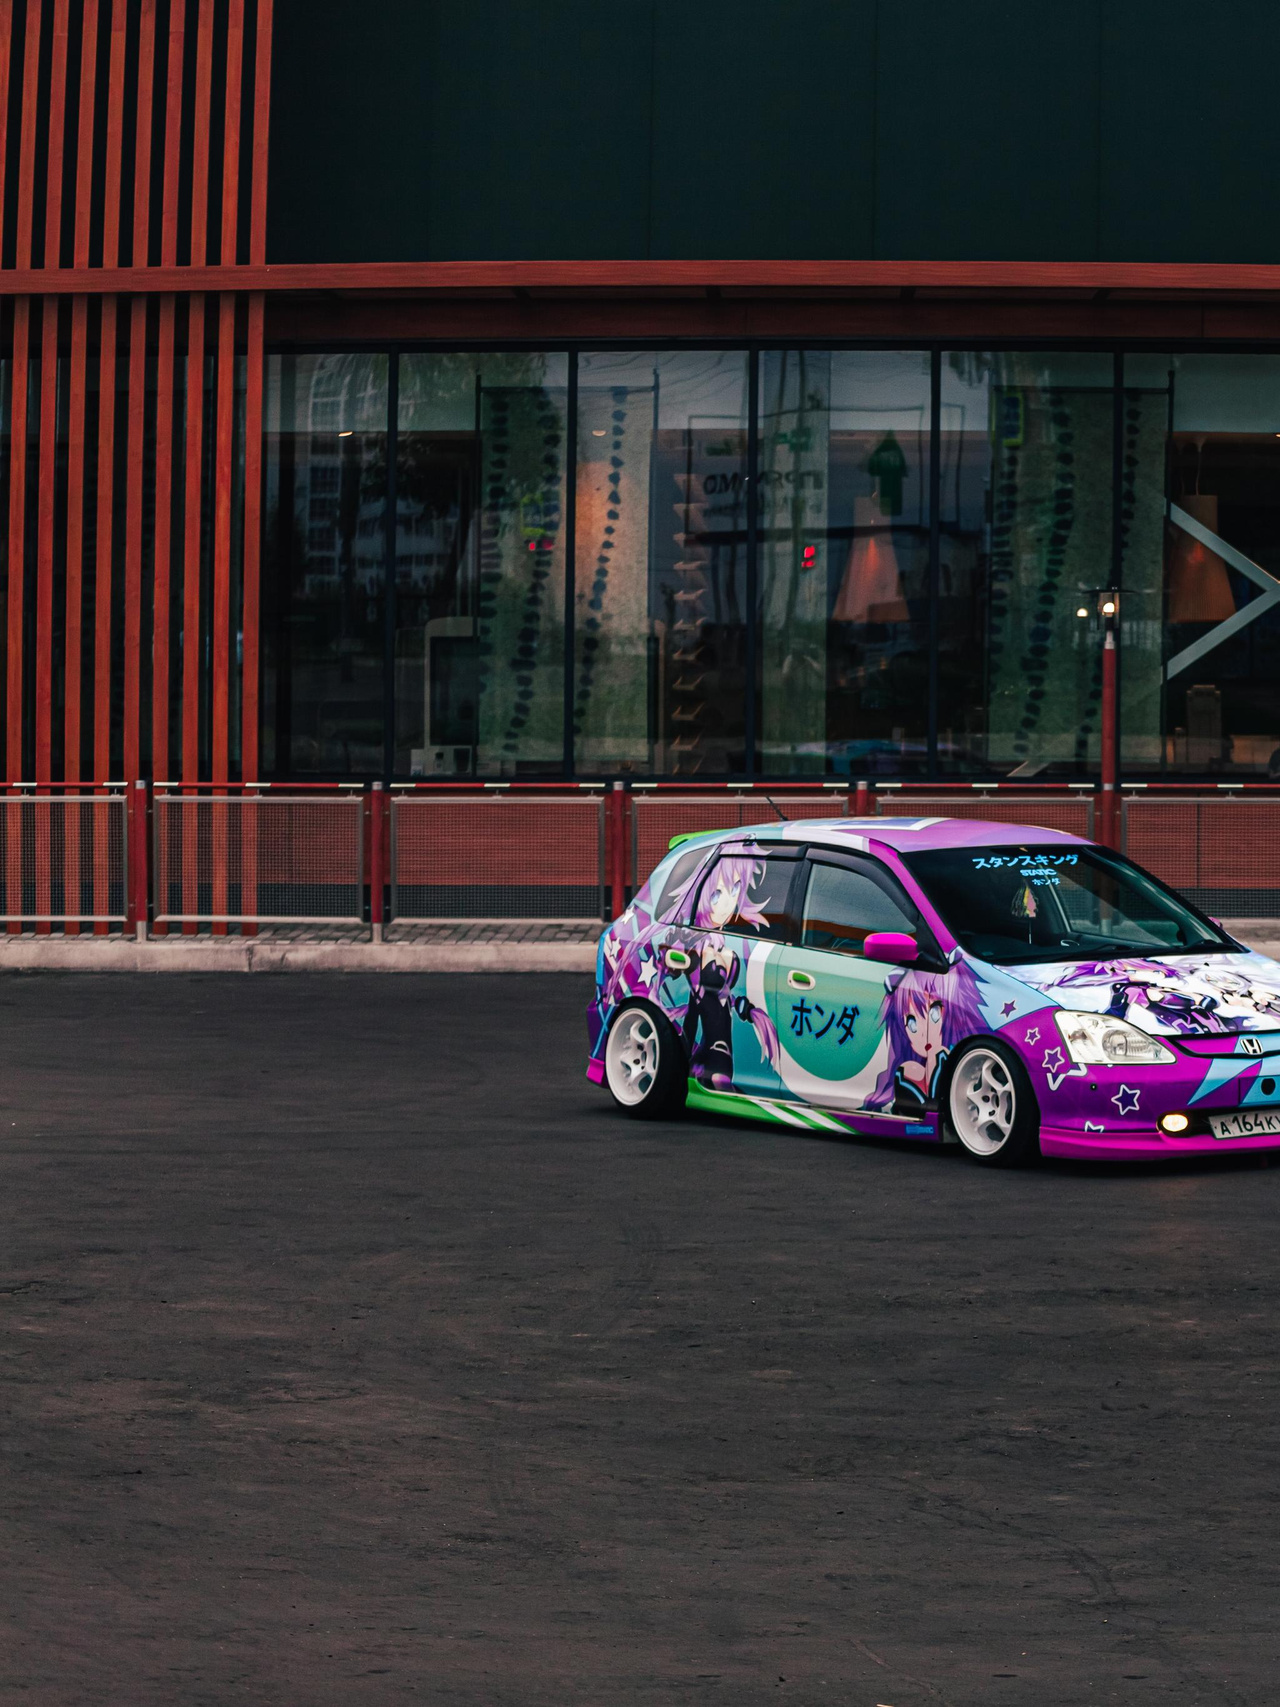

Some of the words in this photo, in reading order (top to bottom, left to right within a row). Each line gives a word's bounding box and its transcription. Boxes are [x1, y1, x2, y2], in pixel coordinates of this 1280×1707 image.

[972, 854, 1079, 870] スタンスキング
[791, 997, 861, 1046] ホンダ
